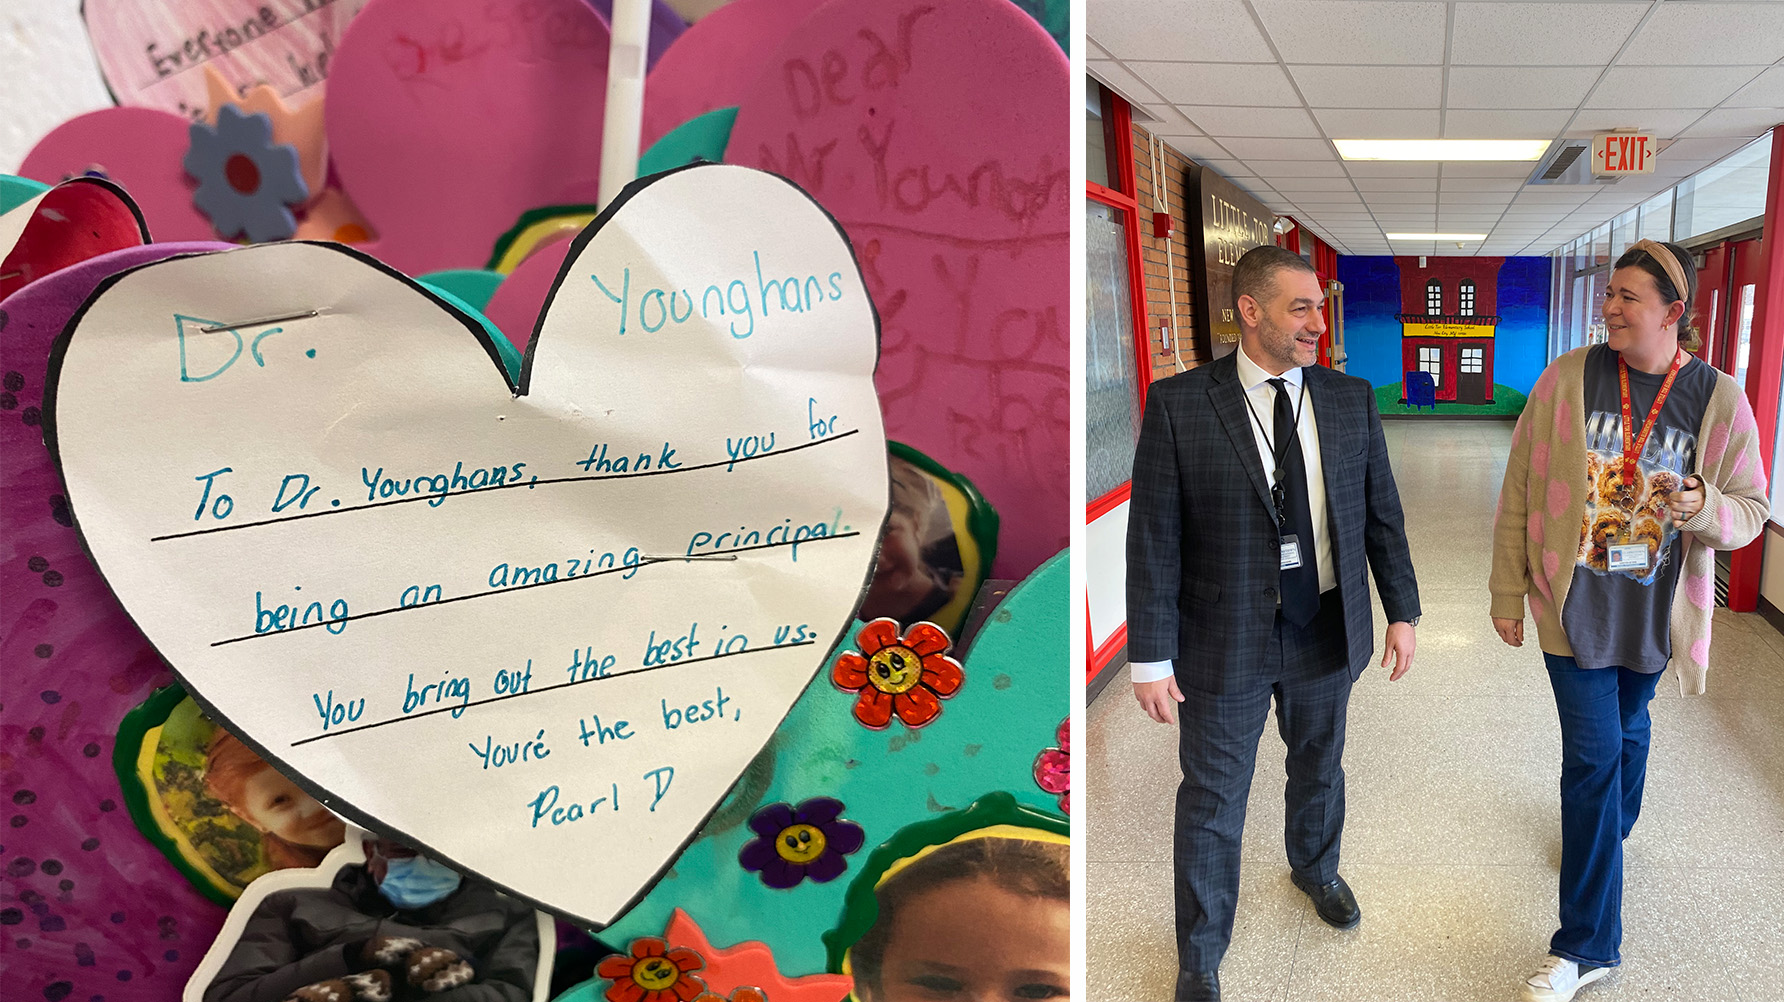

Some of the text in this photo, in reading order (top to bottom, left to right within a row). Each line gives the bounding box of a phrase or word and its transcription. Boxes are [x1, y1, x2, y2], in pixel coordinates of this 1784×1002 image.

[783, 6, 936, 120] Dear
[1604, 136, 1648, 171] EXIT
[1211, 194, 1268, 246] LITTLE TOR
[174, 314, 317, 383] Dr.
[590, 250, 842, 339] Younghans
[194, 397, 838, 520] To Dr. Younghans, thank you for
[255, 506, 853, 635] being an amazing principal.
[313, 622, 817, 731] You bring out the best in us.
[578, 715, 636, 747] the
[661, 687, 741, 730] best,
[643, 766, 675, 812] D
